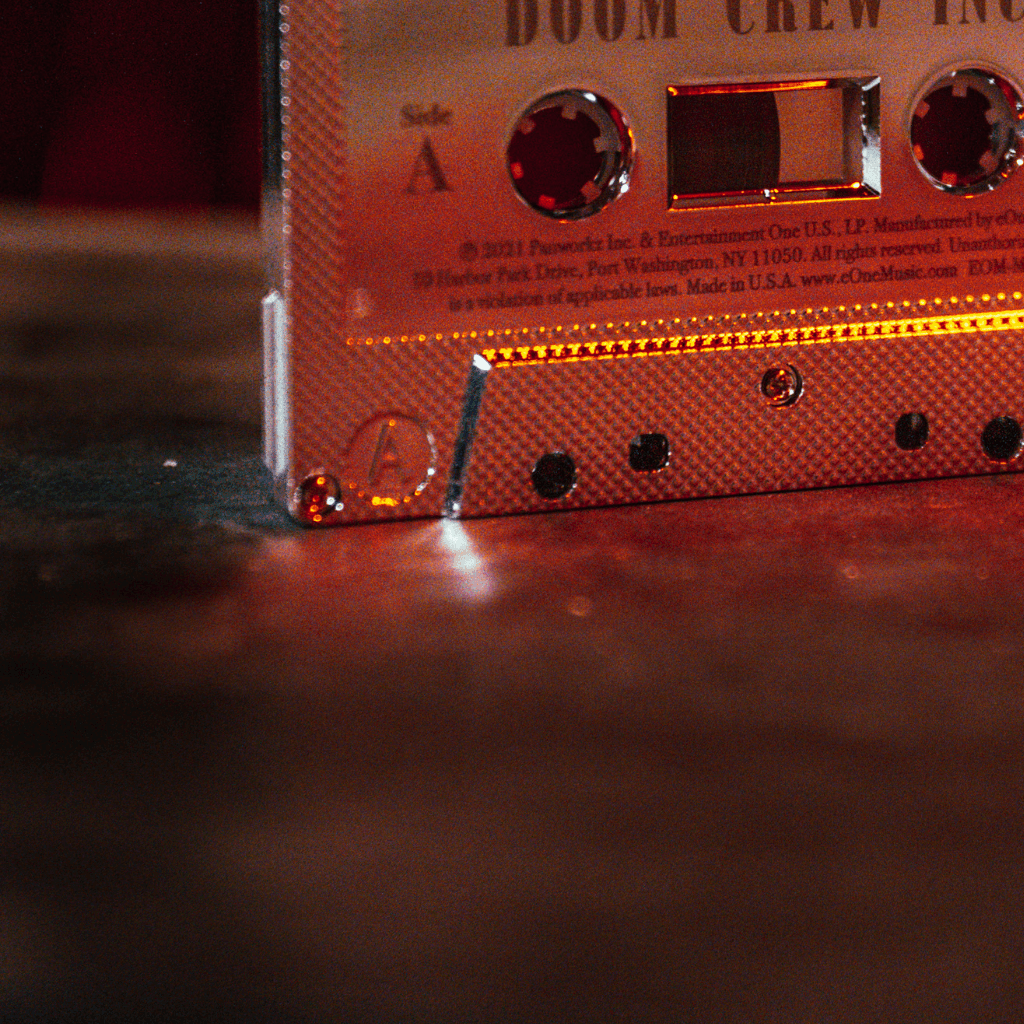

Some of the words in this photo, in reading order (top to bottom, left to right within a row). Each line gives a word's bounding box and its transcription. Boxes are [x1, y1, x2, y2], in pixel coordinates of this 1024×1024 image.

[401, 137, 455, 195] A
[640, 231, 653, 249] &
[658, 228, 765, 247] Entertainment
[768, 224, 801, 240] One
[874, 212, 972, 233] Manufactured
[976, 212, 992, 232] by
[536, 263, 583, 281] Drive,
[587, 260, 619, 277] Port
[624, 256, 719, 275] Washington,
[723, 250, 748, 268] NY
[752, 247, 806, 266] 11050.
[811, 244, 832, 262] All
[836, 243, 876, 264] rights
[478, 291, 544, 310] violation
[548, 286, 565, 304] of
[567, 282, 643, 307] applicable
[687, 277, 727, 295] Made
[730, 275, 745, 292] in
[801, 265, 958, 287] www.eOneMusic.com
